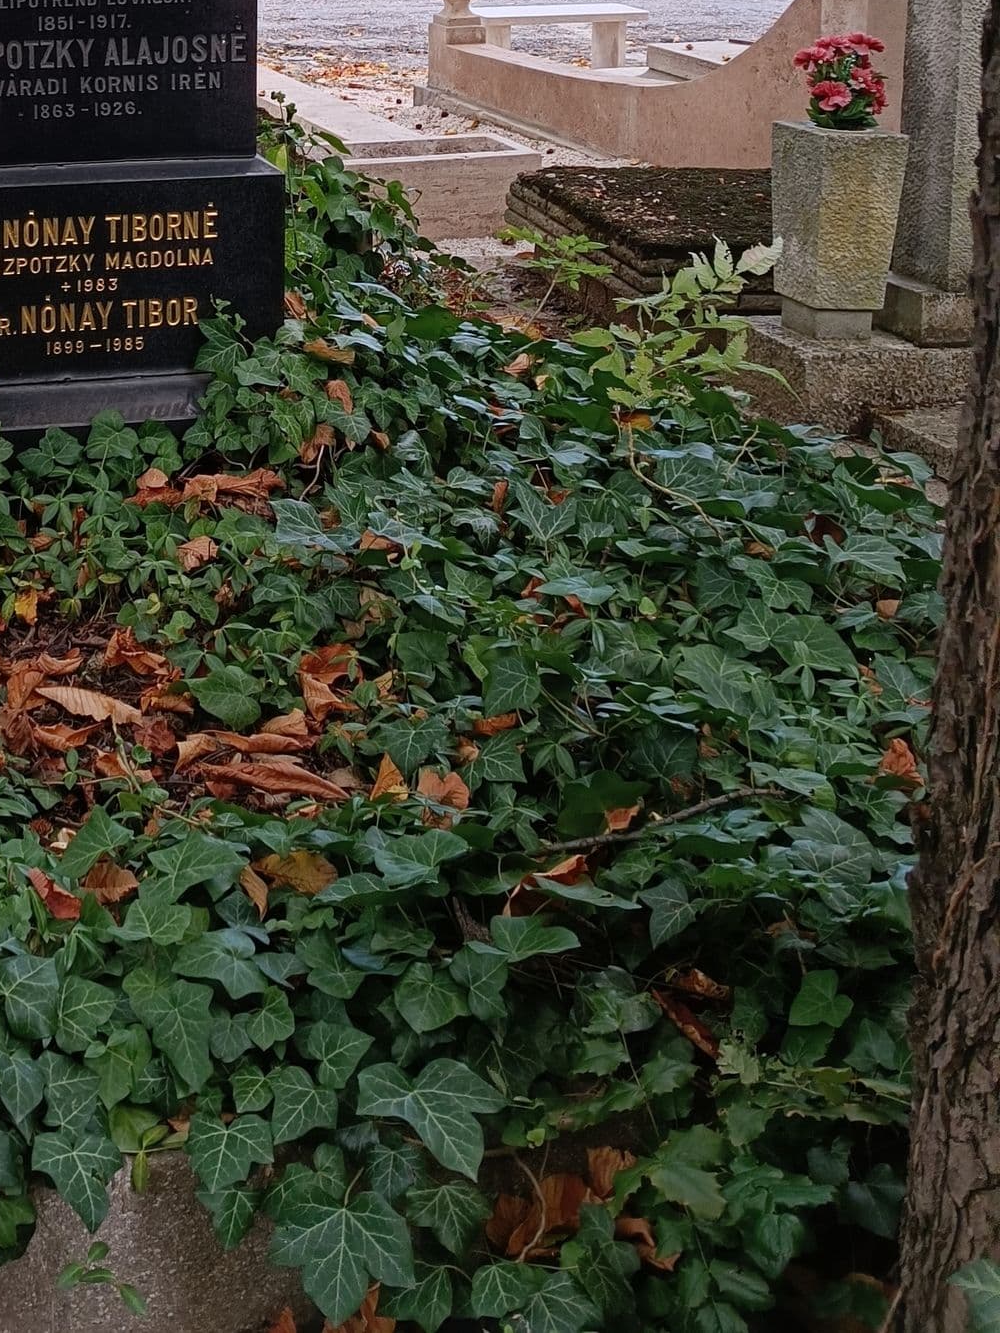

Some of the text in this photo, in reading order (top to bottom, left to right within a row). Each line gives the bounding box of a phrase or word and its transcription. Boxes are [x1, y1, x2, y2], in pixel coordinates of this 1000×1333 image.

[104, 24, 247, 66] ALAJOSNÉ
[80, 75, 158, 93] KORNIS
[170, 66, 221, 90] IRÉN
[3, 210, 95, 249] NÓNAY
[105, 202, 219, 243] TIBORNÉ
[105, 247, 214, 270] MAGDOLNA
[21, 295, 113, 335] NÓNAY
[122, 297, 199, 327] TIBOR
